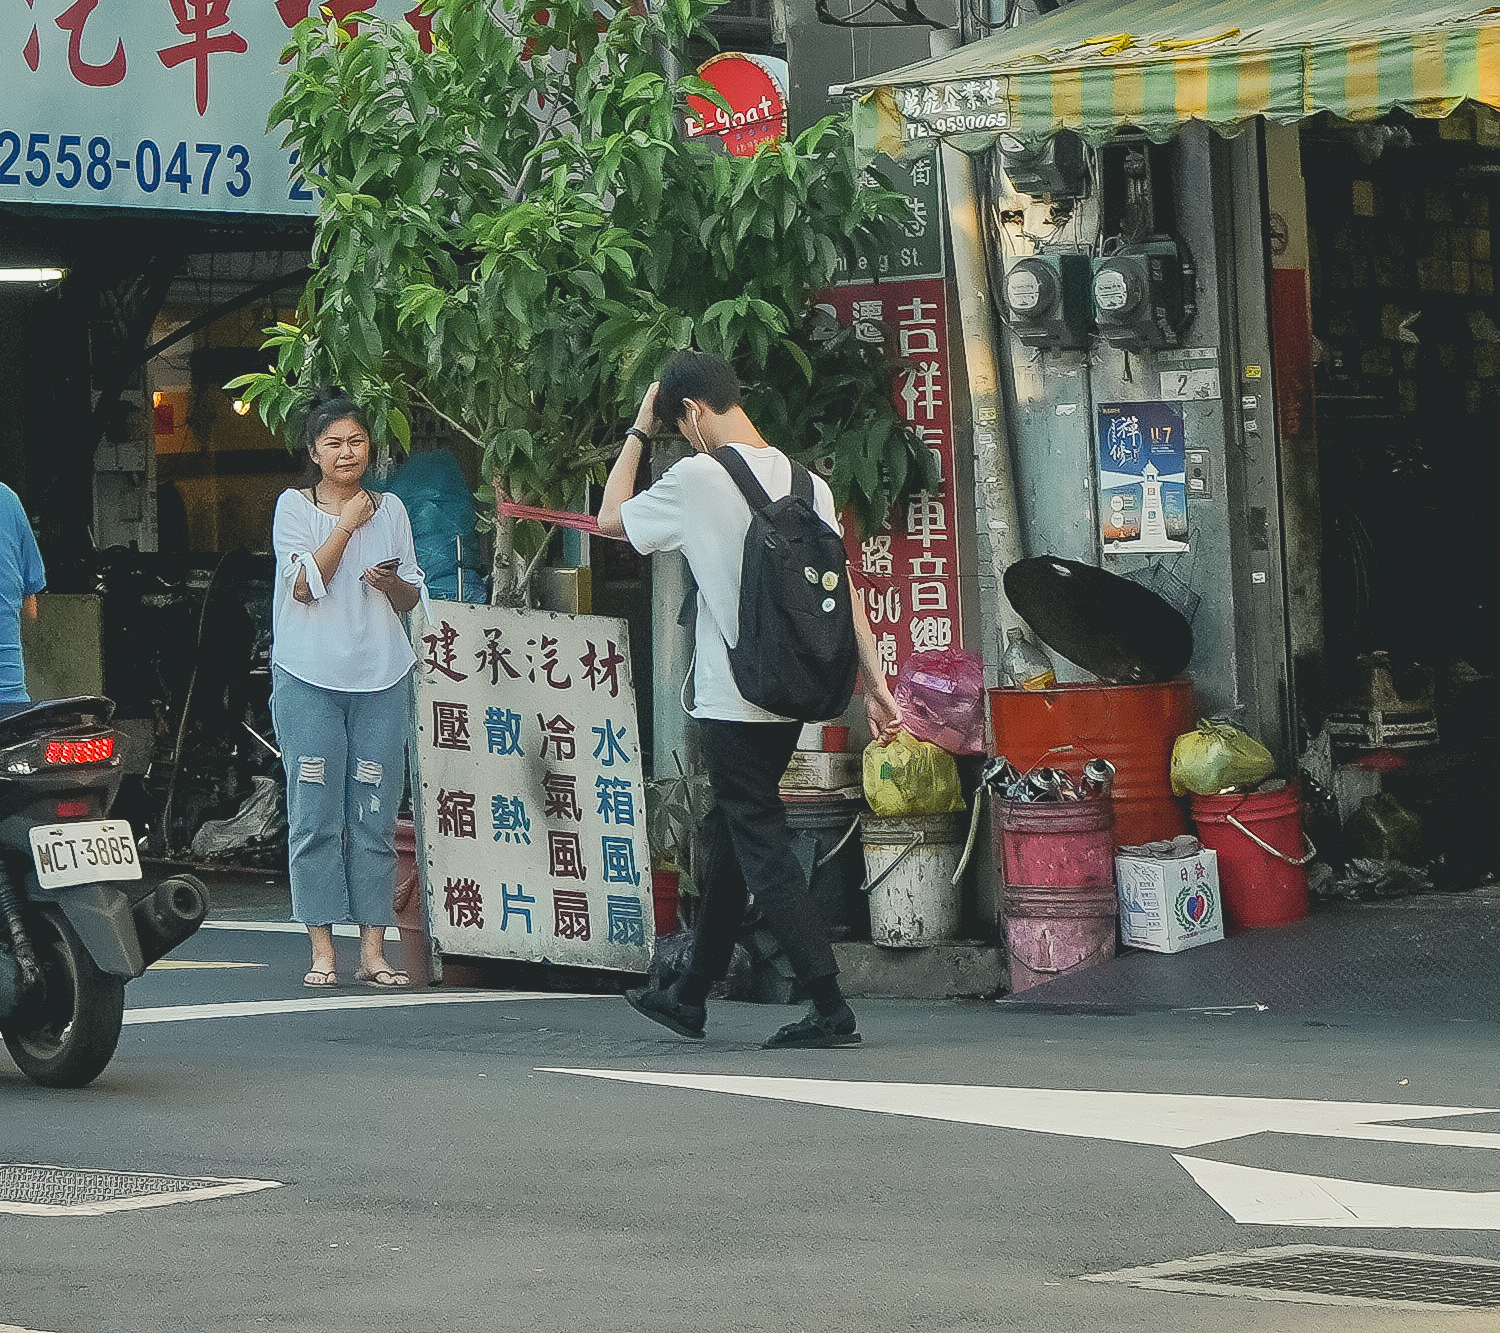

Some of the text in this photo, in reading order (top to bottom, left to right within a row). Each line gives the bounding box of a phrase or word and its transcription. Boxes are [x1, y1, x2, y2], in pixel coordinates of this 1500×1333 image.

[422, 620, 624, 698] 建承汽材
[432, 701, 484, 929] 壓縮機
[484, 707, 535, 933] 散熱片
[537, 713, 592, 941] 冷氣風扇
[592, 719, 645, 946] 水箱風扇
